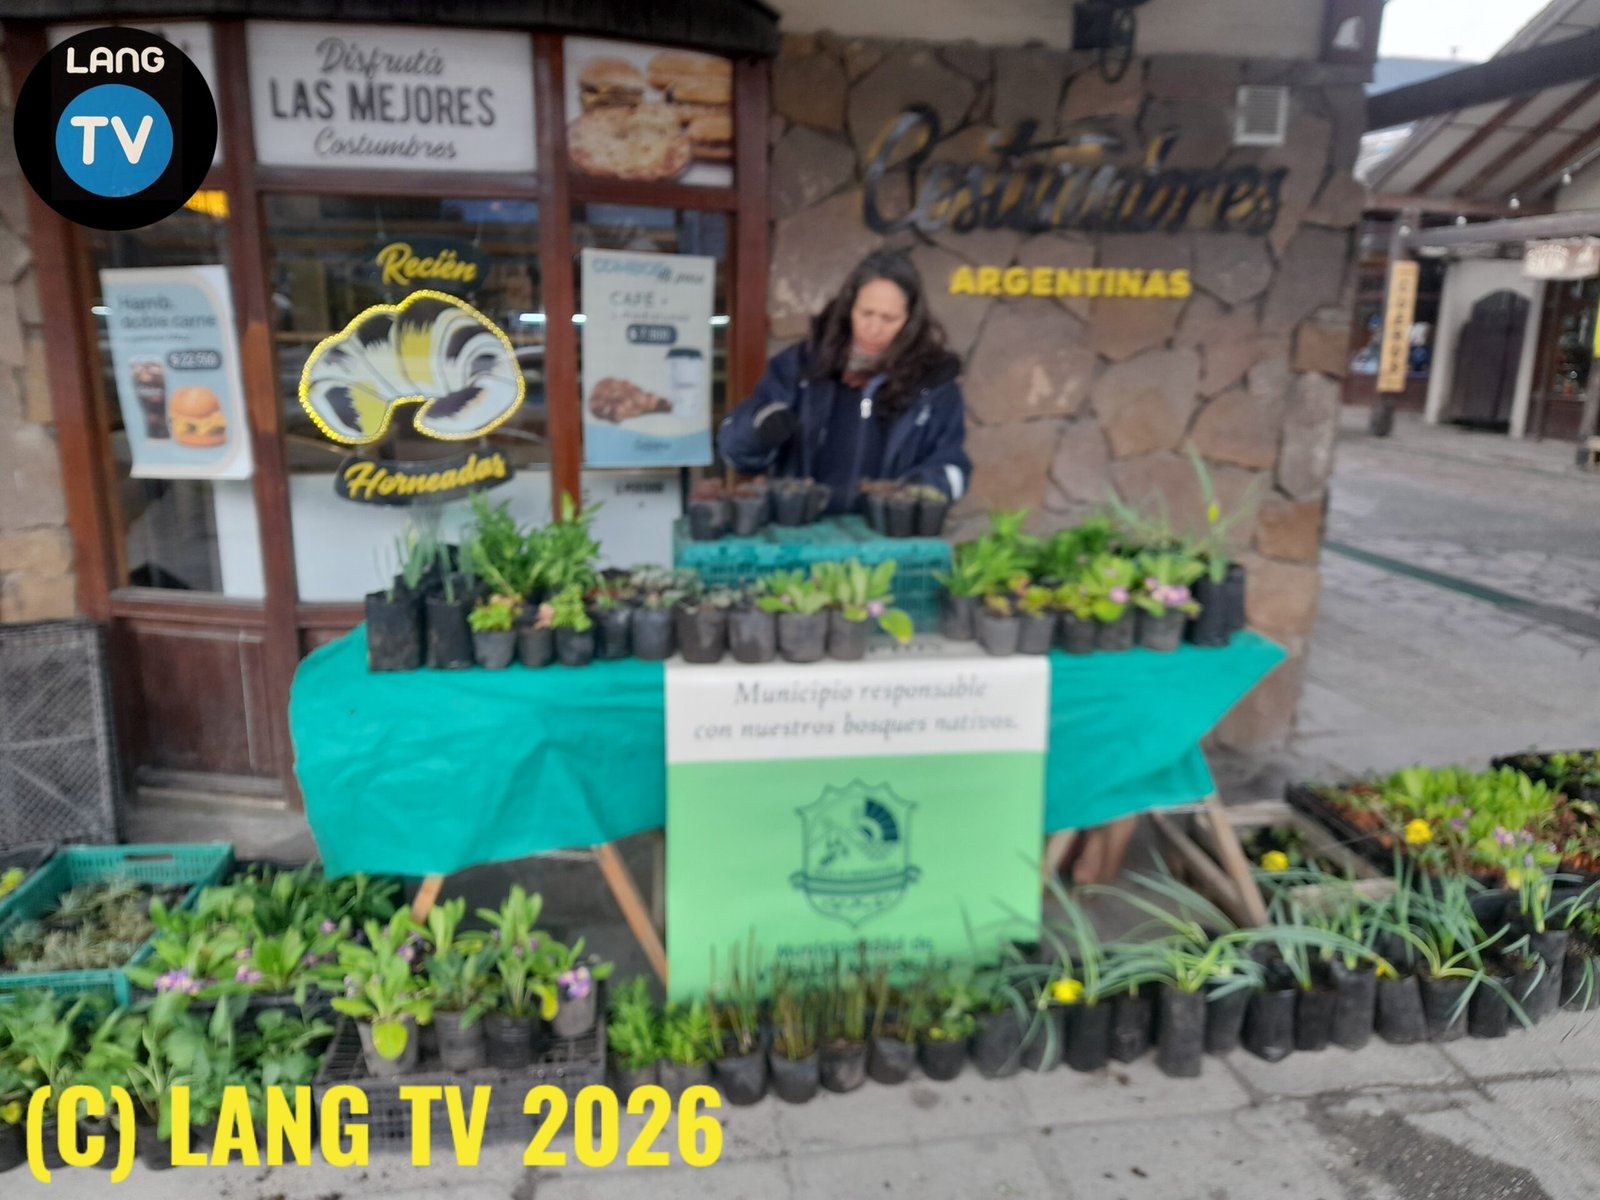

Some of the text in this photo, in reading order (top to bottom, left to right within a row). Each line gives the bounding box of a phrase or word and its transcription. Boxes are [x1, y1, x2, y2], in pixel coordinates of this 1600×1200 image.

[268, 77, 497, 128] LAS MEJORES
[314, 125, 458, 160] Costumbres
[863, 104, 1289, 236] Costumbres
[948, 265, 1192, 299] ARGENTINAS
[344, 453, 508, 501] Horneados
[734, 674, 990, 710] Municipio responsable
[693, 709, 1020, 742] con nuestros bosques nativos.
